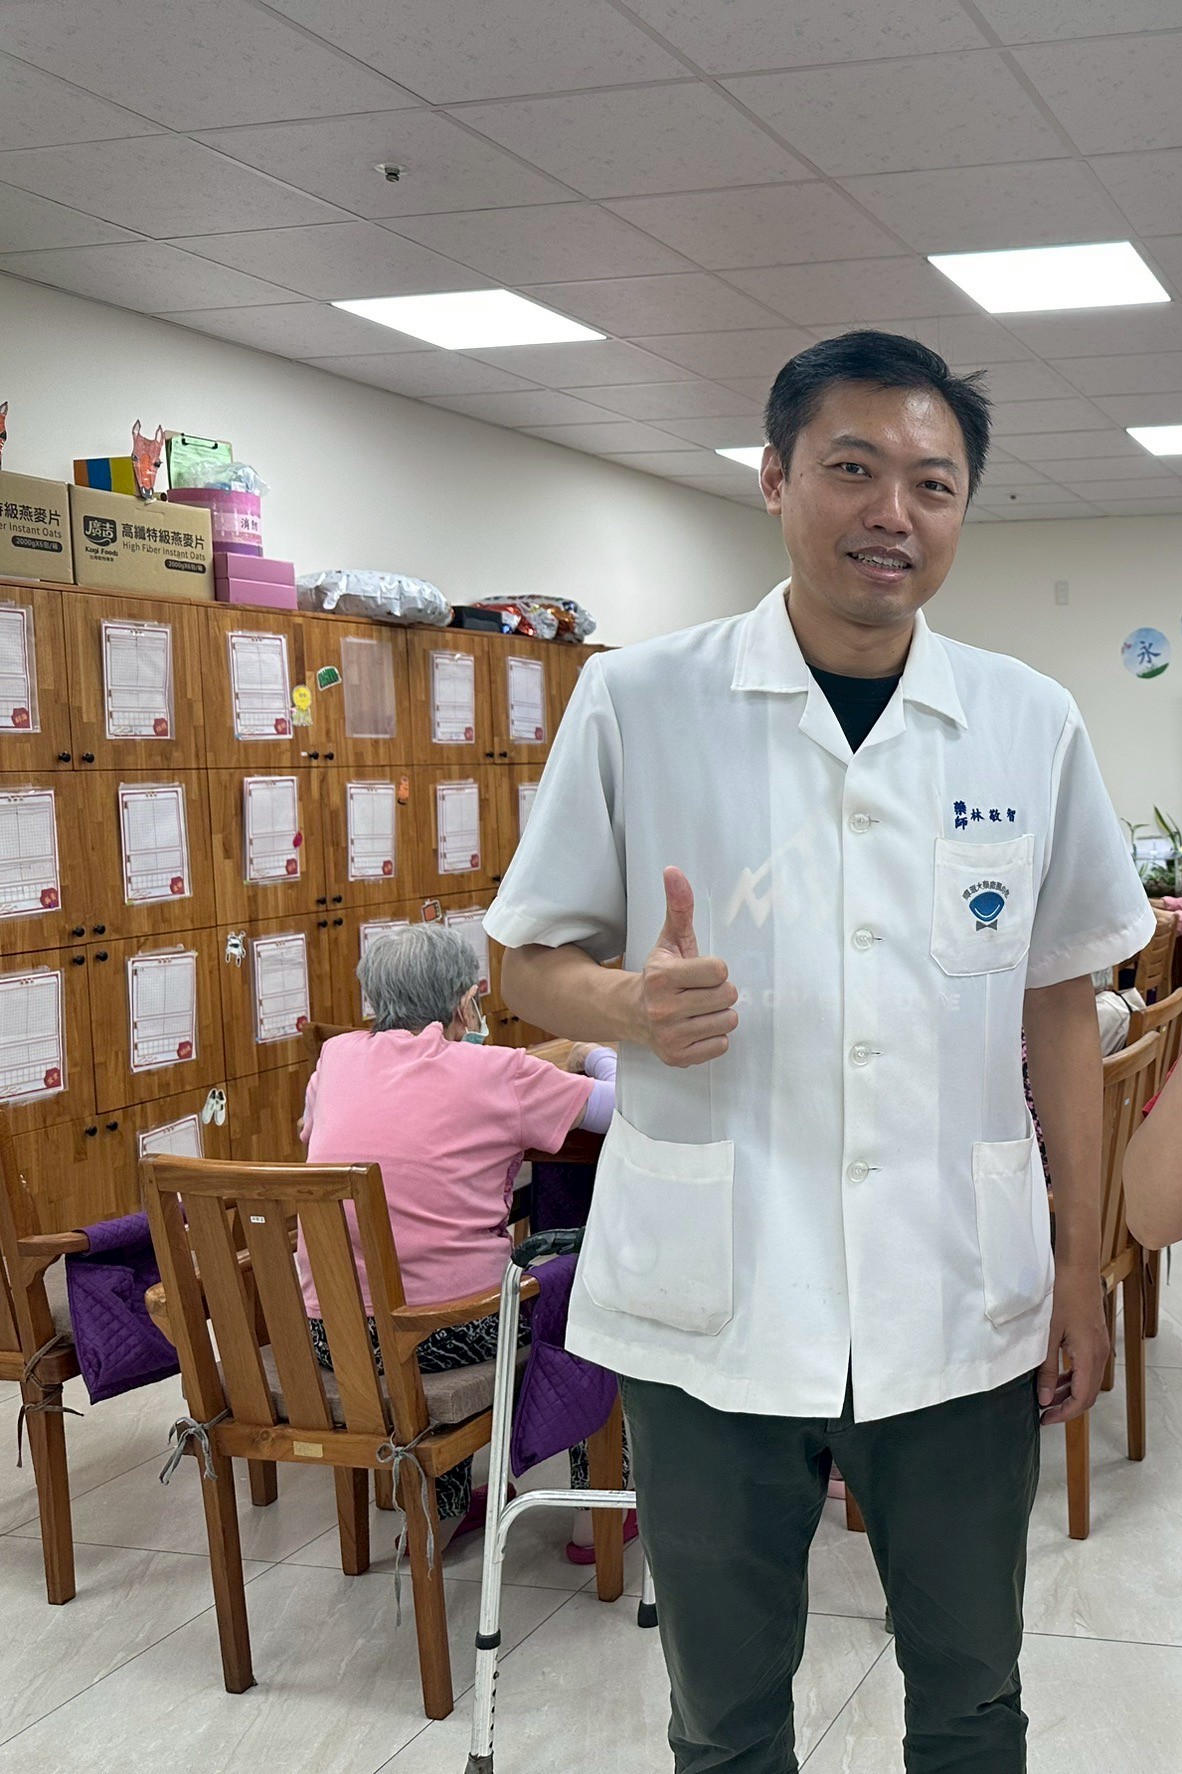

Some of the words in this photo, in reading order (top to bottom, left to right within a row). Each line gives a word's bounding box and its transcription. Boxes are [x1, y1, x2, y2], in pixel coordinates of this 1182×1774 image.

[9, 521, 40, 536] Instant
[42, 527, 62, 539] Oats
[85, 519, 115, 539] 廣吉
[121, 523, 205, 550] 高纖特級燕麥片
[101, 547, 118, 557] Foods
[122, 541, 140, 553] High
[142, 543, 161, 555] Fiber
[162, 546, 188, 560] Instant
[189, 551, 206, 562] Oats
[953, 800, 968, 830] 藥師
[970, 808, 1016, 823] 林敬智
